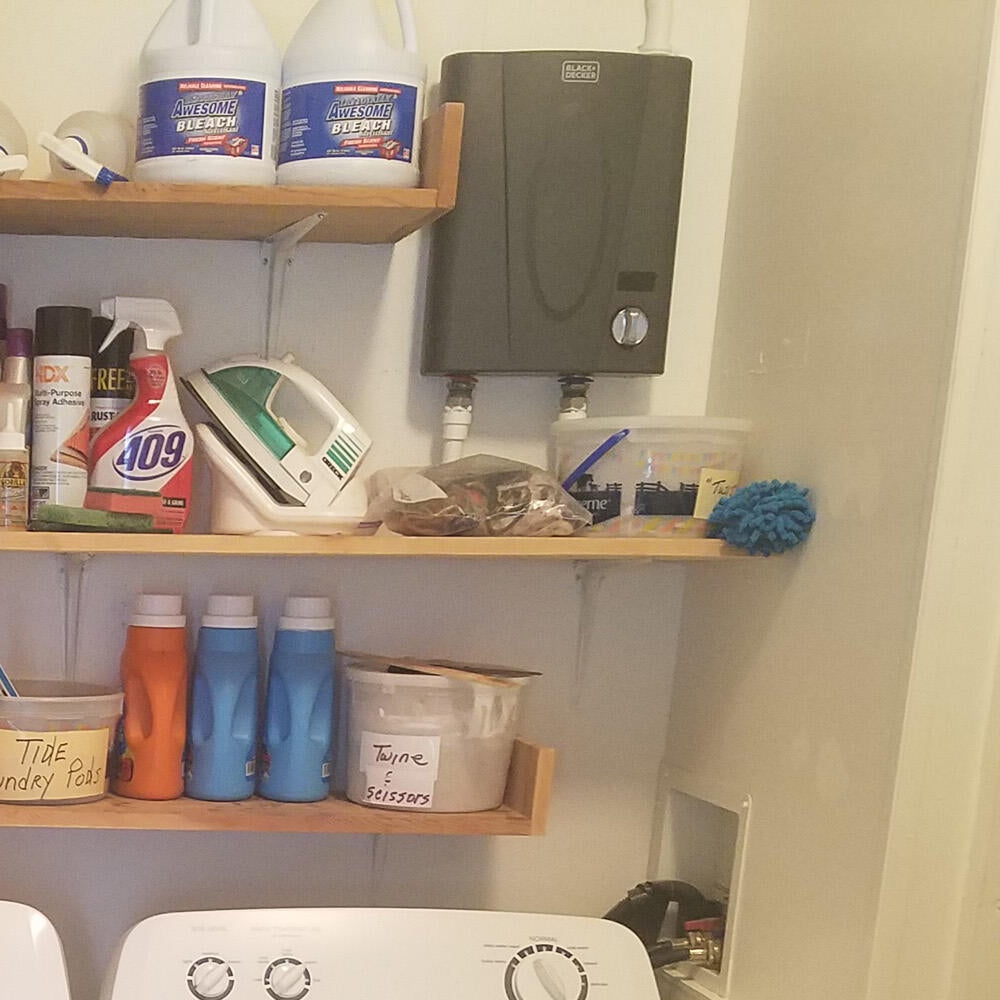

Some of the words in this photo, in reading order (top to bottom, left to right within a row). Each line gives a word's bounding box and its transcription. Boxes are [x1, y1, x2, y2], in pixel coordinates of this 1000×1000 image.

[565, 71, 596, 79] DECKER
[172, 99, 238, 118] AWESOME
[327, 102, 393, 121] AWESOME
[176, 117, 236, 132] BLEACH
[331, 120, 391, 135] BLEACH
[116, 430, 187, 472] 409
[373, 744, 429, 766] Twine
